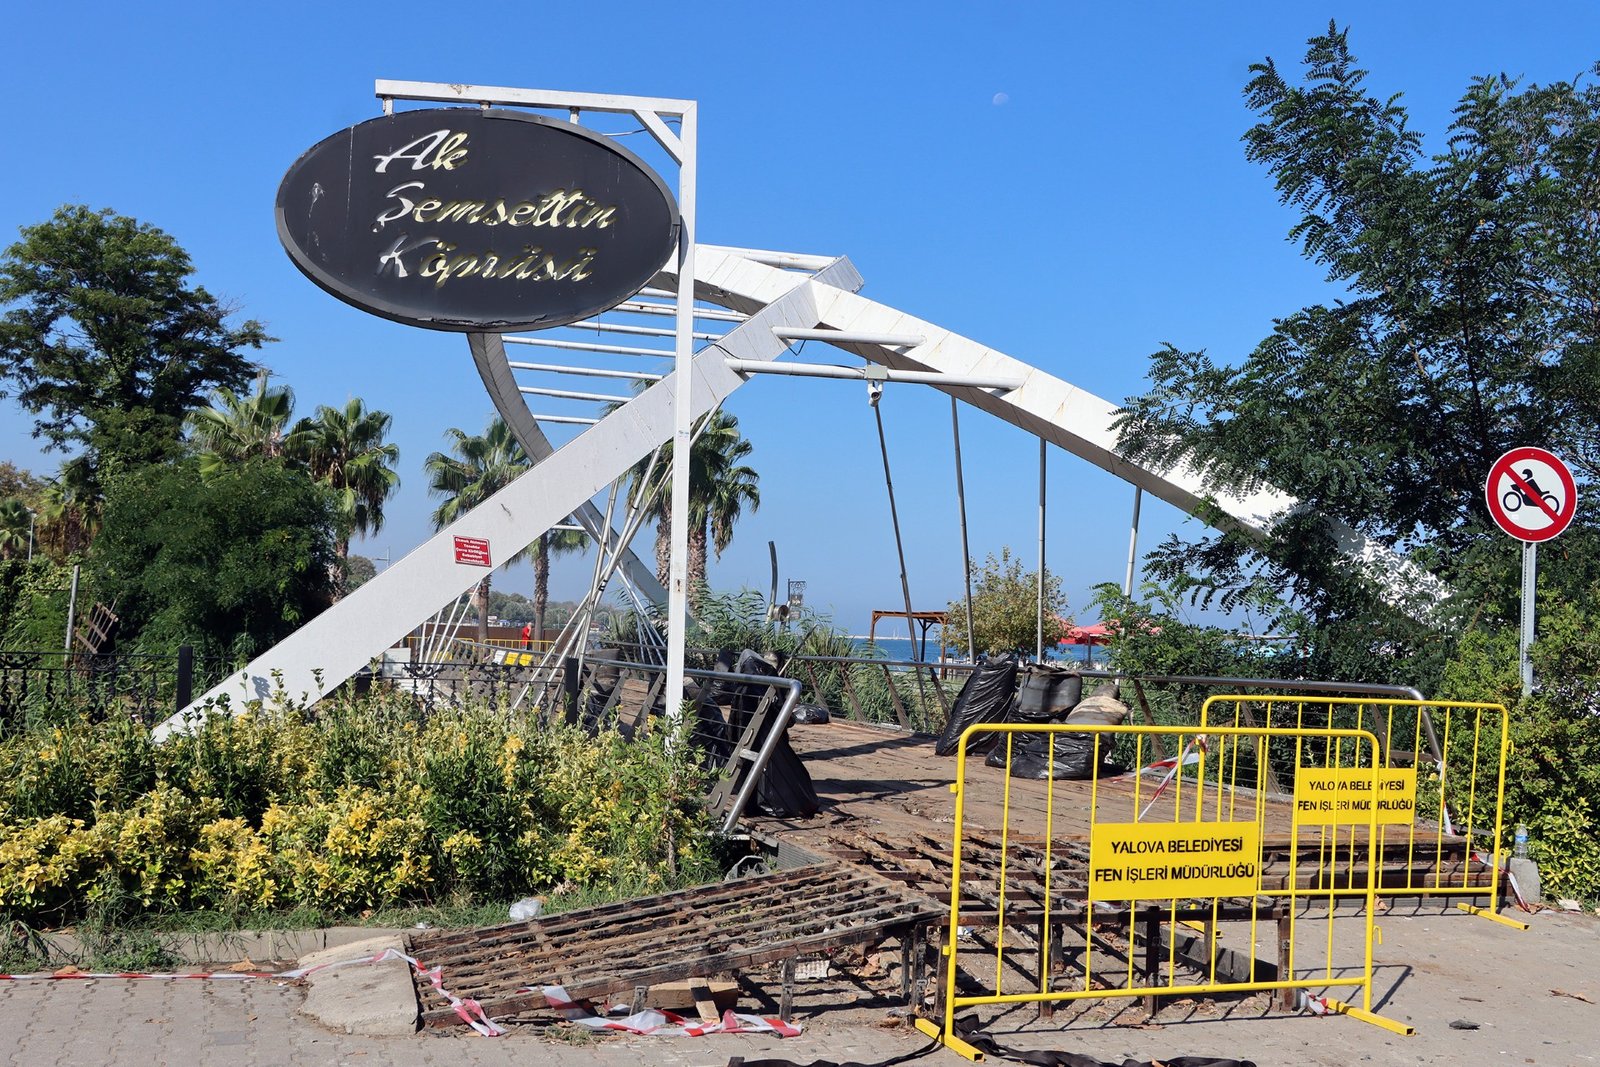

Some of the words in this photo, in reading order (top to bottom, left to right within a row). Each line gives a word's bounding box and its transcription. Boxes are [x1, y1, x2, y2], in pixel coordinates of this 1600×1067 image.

[373, 128, 470, 173] Ak
[376, 233, 599, 289] Köprüsü
[1349, 779, 1405, 791] BELEİYESİ
[1297, 800, 1317, 811] FEN
[1111, 840, 1165, 854] YALOVA
[1167, 836, 1243, 853] BELEDİYESİ
[1095, 868, 1122, 882] FEN
[1126, 865, 1168, 884] İŞLERİ
[1171, 861, 1255, 880] MÜDÜRLÜĞÜ
